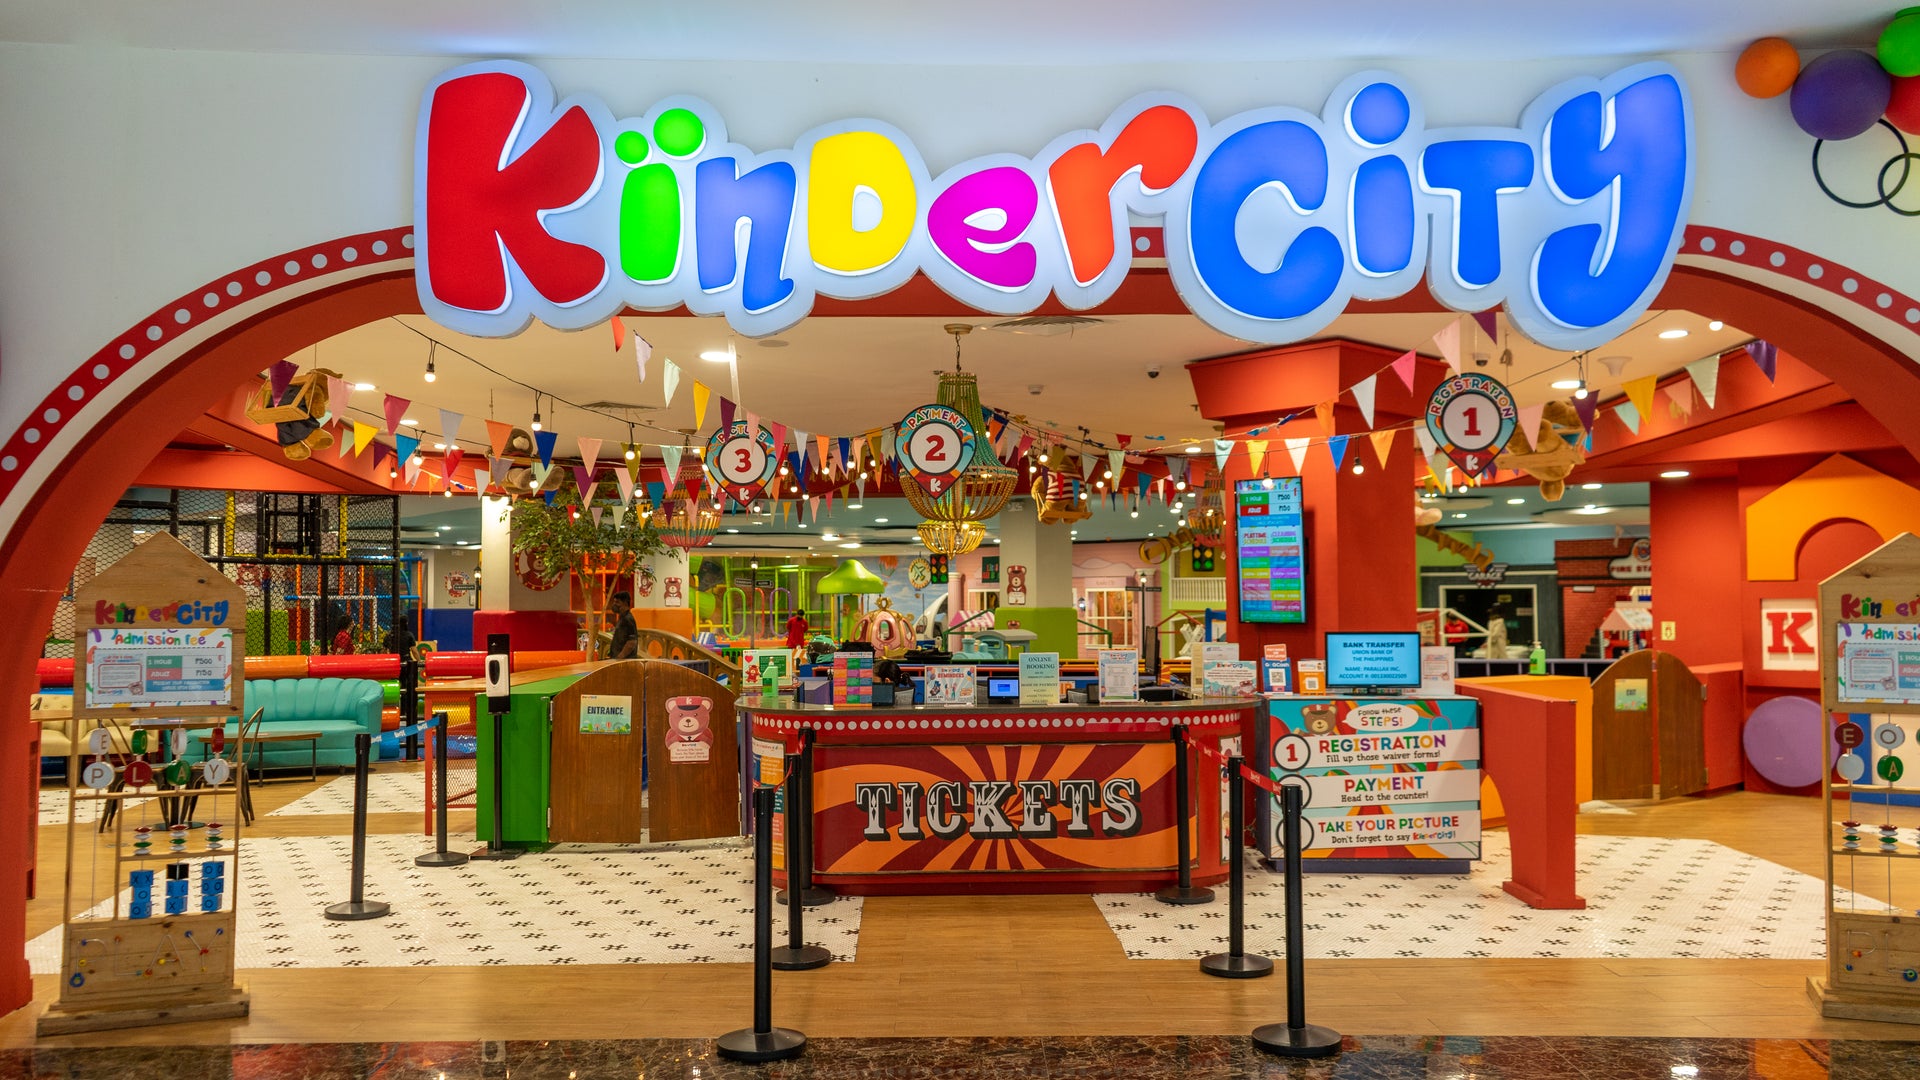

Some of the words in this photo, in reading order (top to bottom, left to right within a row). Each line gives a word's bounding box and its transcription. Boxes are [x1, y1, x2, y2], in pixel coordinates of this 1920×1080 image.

[1429, 378, 1514, 418] REGISTRATION
[907, 408, 966, 429] PAYMENT
[1462, 407, 1481, 436] 1
[716, 424, 767, 443] PCTUE
[925, 434, 946, 461] 2
[734, 448, 752, 473] 3
[115, 630, 181, 645] Admission
[185, 634, 206, 645] fee
[1766, 612, 1815, 654] K
[587, 706, 624, 715] ENTRANCE
[1361, 716, 1404, 726] STEPS!
[1319, 734, 1446, 753] REGISTRATION
[1285, 744, 1298, 762] 1
[1326, 753, 1340, 763] Fill
[1343, 755, 1354, 763] up
[1357, 753, 1380, 761] those
[1382, 752, 1411, 760] waiver
[1413, 750, 1441, 759] forms!
[1344, 776, 1424, 792] PAYMENT
[1341, 794, 1362, 802] Head
[1394, 791, 1429, 799] counter!
[855, 778, 1142, 842] TICKETS
[1318, 821, 1353, 833] TAKE
[1356, 819, 1395, 831] YOUR
[1399, 816, 1459, 829] PICTURE
[1331, 835, 1353, 844] Don't
[1356, 834, 1382, 844] forget
[1396, 834, 1410, 842] say
